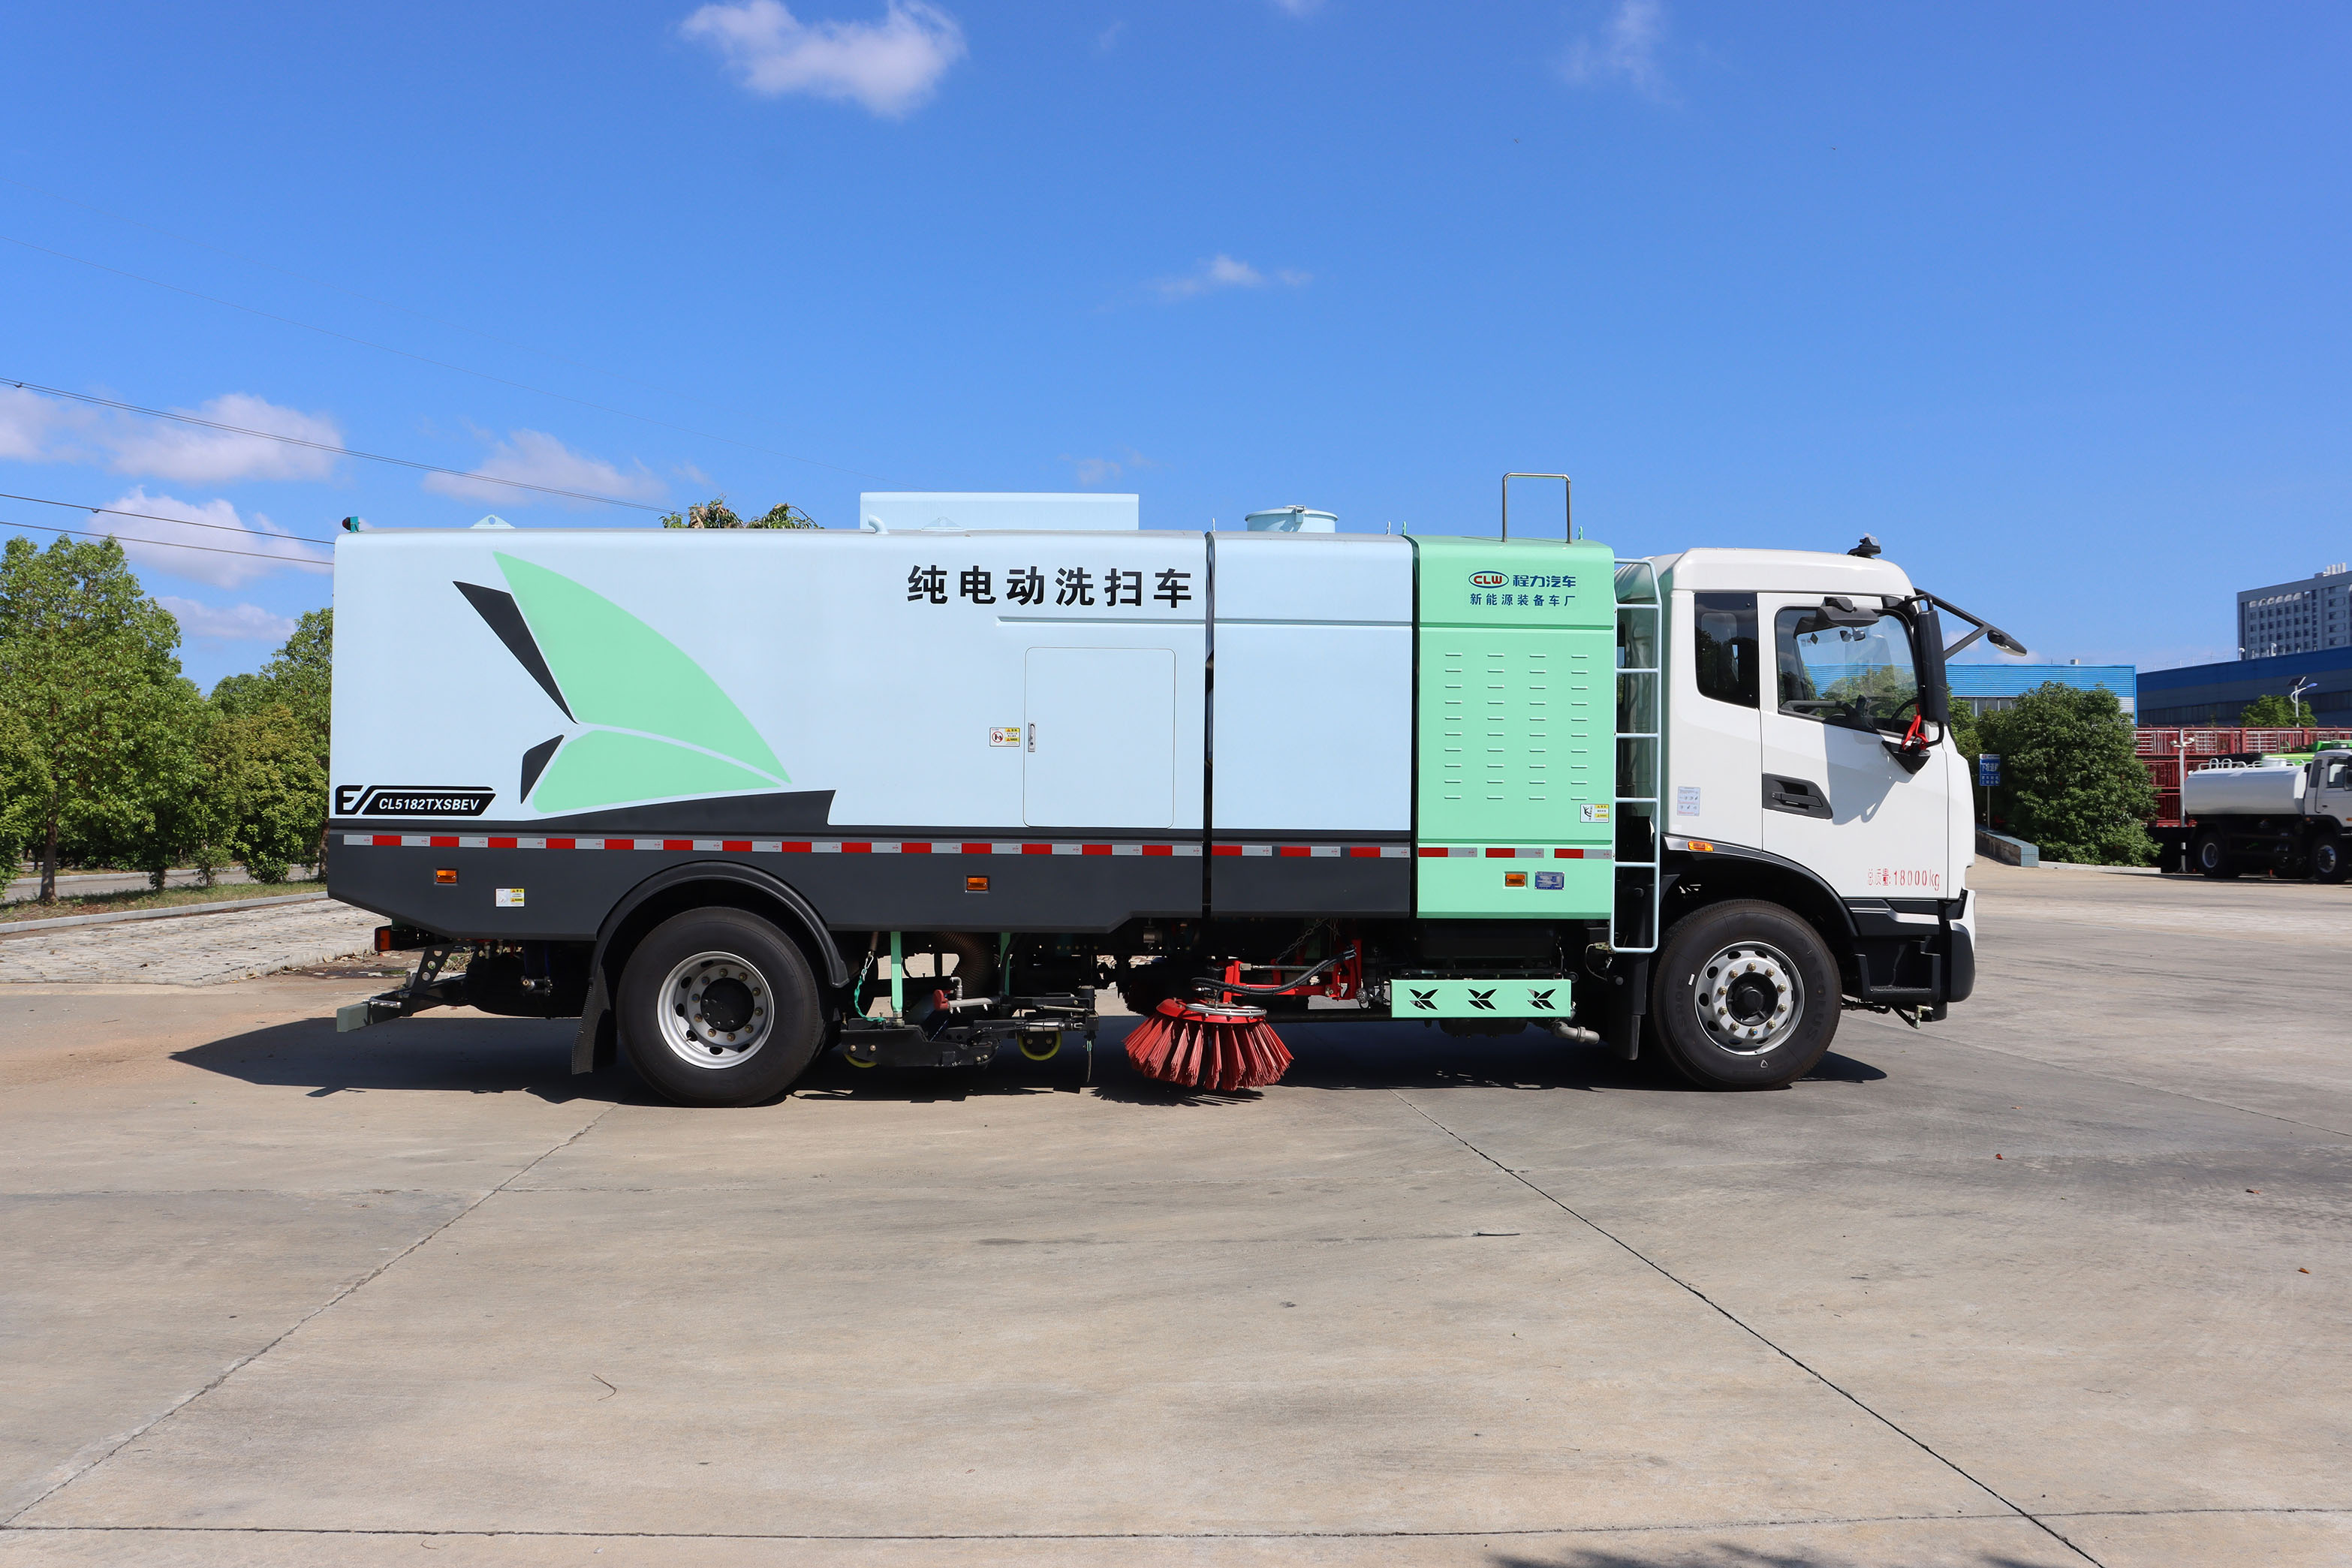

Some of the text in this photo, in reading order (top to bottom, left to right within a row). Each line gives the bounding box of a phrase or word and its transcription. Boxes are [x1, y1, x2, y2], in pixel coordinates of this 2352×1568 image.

[1474, 575, 1503, 584] CLW
[1513, 575, 1576, 588] 程力汽车
[907, 564, 1192, 609] 纯电动洗扫车
[1470, 593, 1576, 606] 新能源装备车厂
[378, 798, 480, 811] CL5182TXSBEV
